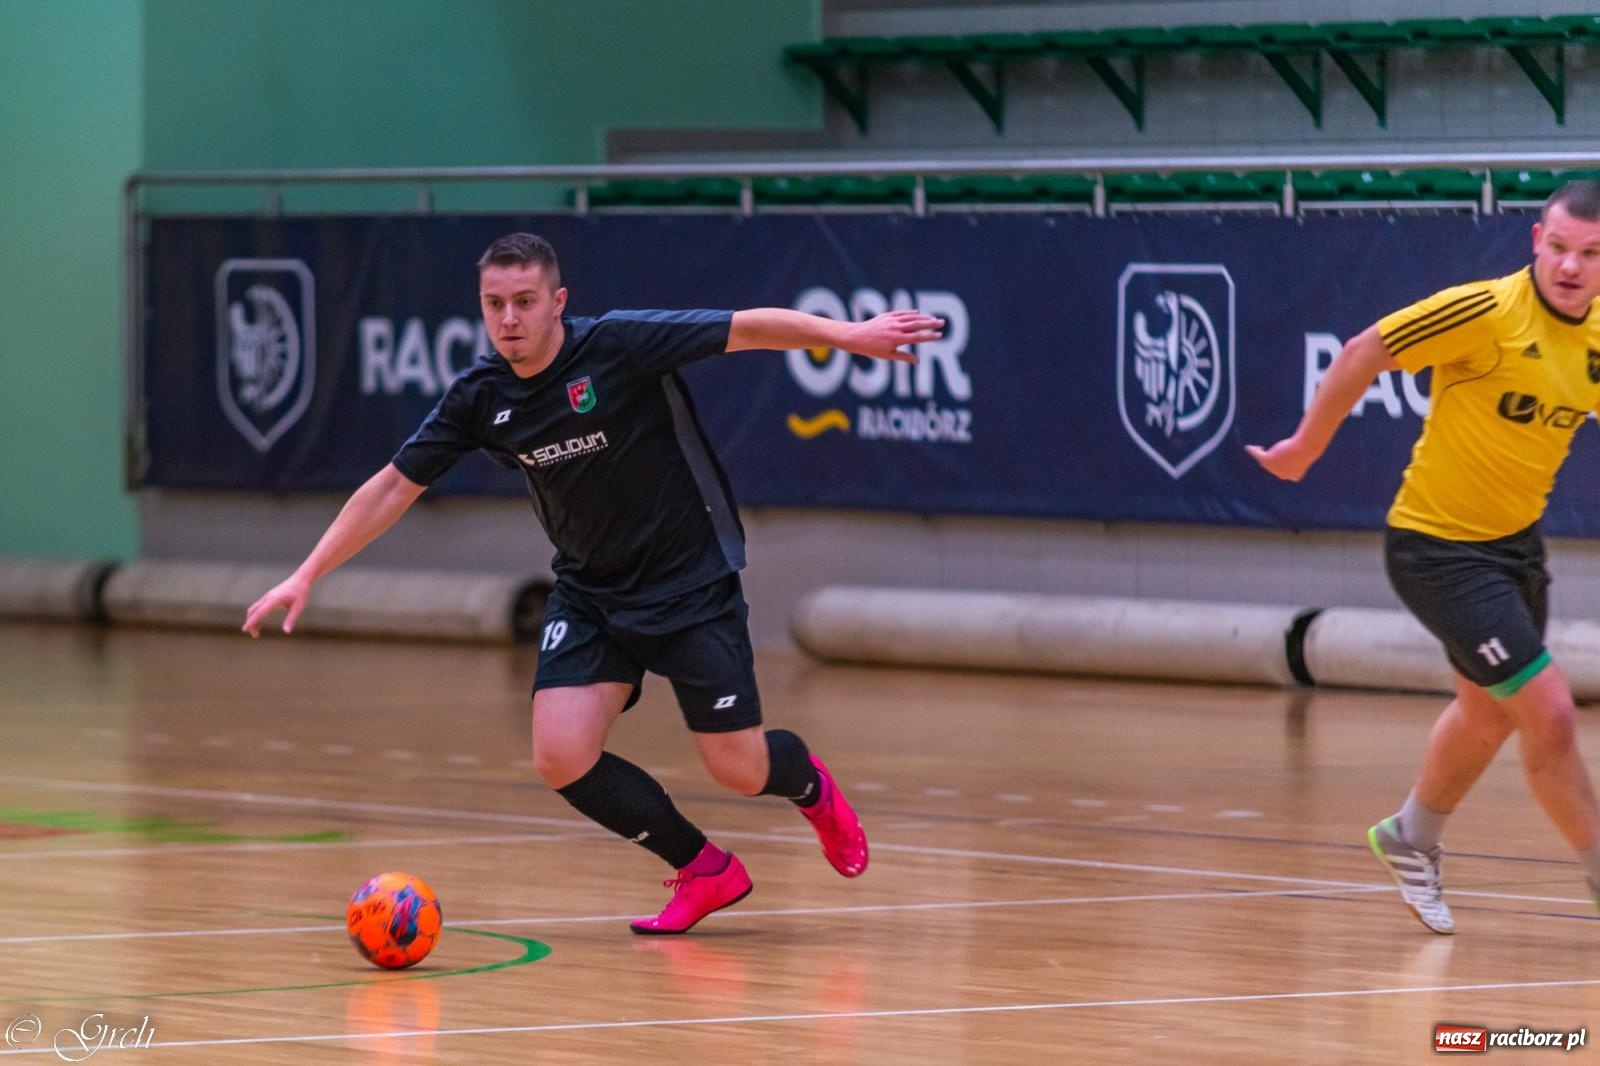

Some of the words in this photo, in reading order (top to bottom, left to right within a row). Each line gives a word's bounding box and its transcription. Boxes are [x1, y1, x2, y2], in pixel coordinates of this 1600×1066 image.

[532, 430, 607, 463] SOLIDUM
[541, 620, 568, 651] 19
[1477, 637, 1510, 667] 11
